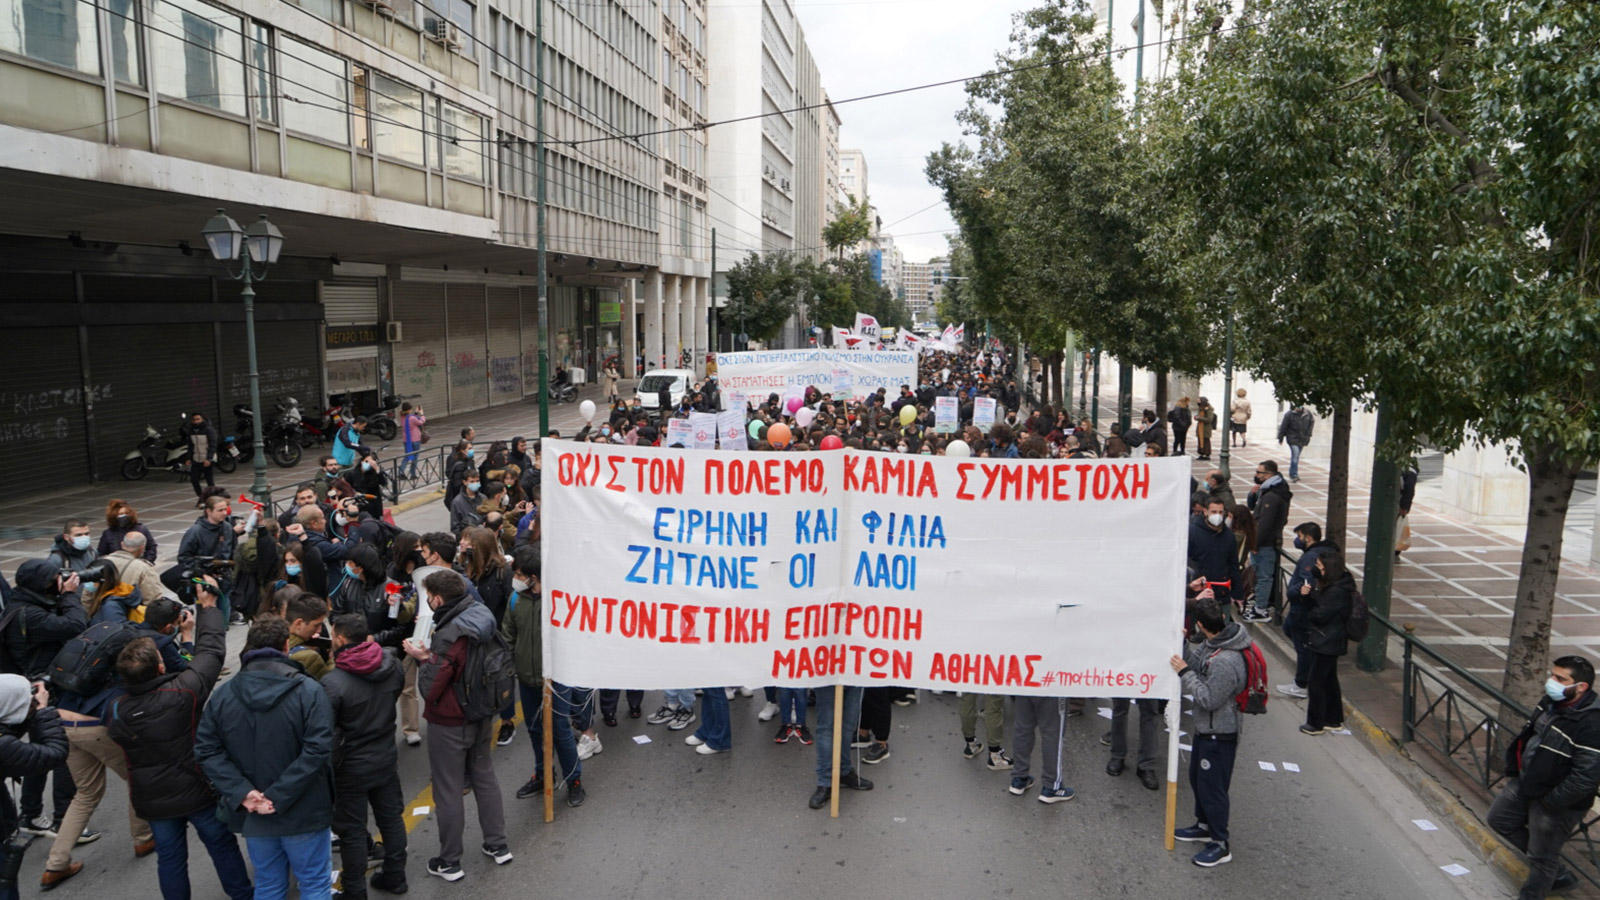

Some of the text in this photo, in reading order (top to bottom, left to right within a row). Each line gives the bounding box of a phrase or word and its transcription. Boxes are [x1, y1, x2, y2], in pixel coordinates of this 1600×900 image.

[718, 355, 732, 366] ΟΧΙ
[756, 352, 820, 363] ΙΜΠΕΡΙΑΛΙΣΤΙΚΟ
[854, 354, 873, 363] ΣΤΗΝ
[875, 353, 915, 364] ΟΥΚΡΑΝΙΑ
[720, 378, 731, 388] ΝΑ
[732, 375, 785, 388] ΣΤΑΜΑΤΗΣΕΙ
[858, 376, 888, 388] ΧΩΡΑΣ
[891, 376, 912, 387] ΜΑΣ
[557, 451, 1150, 501] ΟΧΙ ΣΤΟΝ ΠΟΛΕΜΟ, ΚΑΜΙΑ ΣΥΜΜΕΤΟΧΗ
[653, 507, 947, 549] ΕΙΡΗΝΗ ΚΑΙ ΦΙΛΙΑ
[625, 545, 917, 591] ΖΗΤΑΝΕ ΟΙ ΛΑΟΙ
[550, 590, 923, 645] ΣΥΝΤΟΝΙΣΤΙΚΗ ΕΠΙΤΡΟΠΗ
[771, 644, 1043, 687] ΜΑΘΗΤΩΝ ΑΘΗΝΑΣ
[1041, 667, 1158, 694] #mathites.gr
